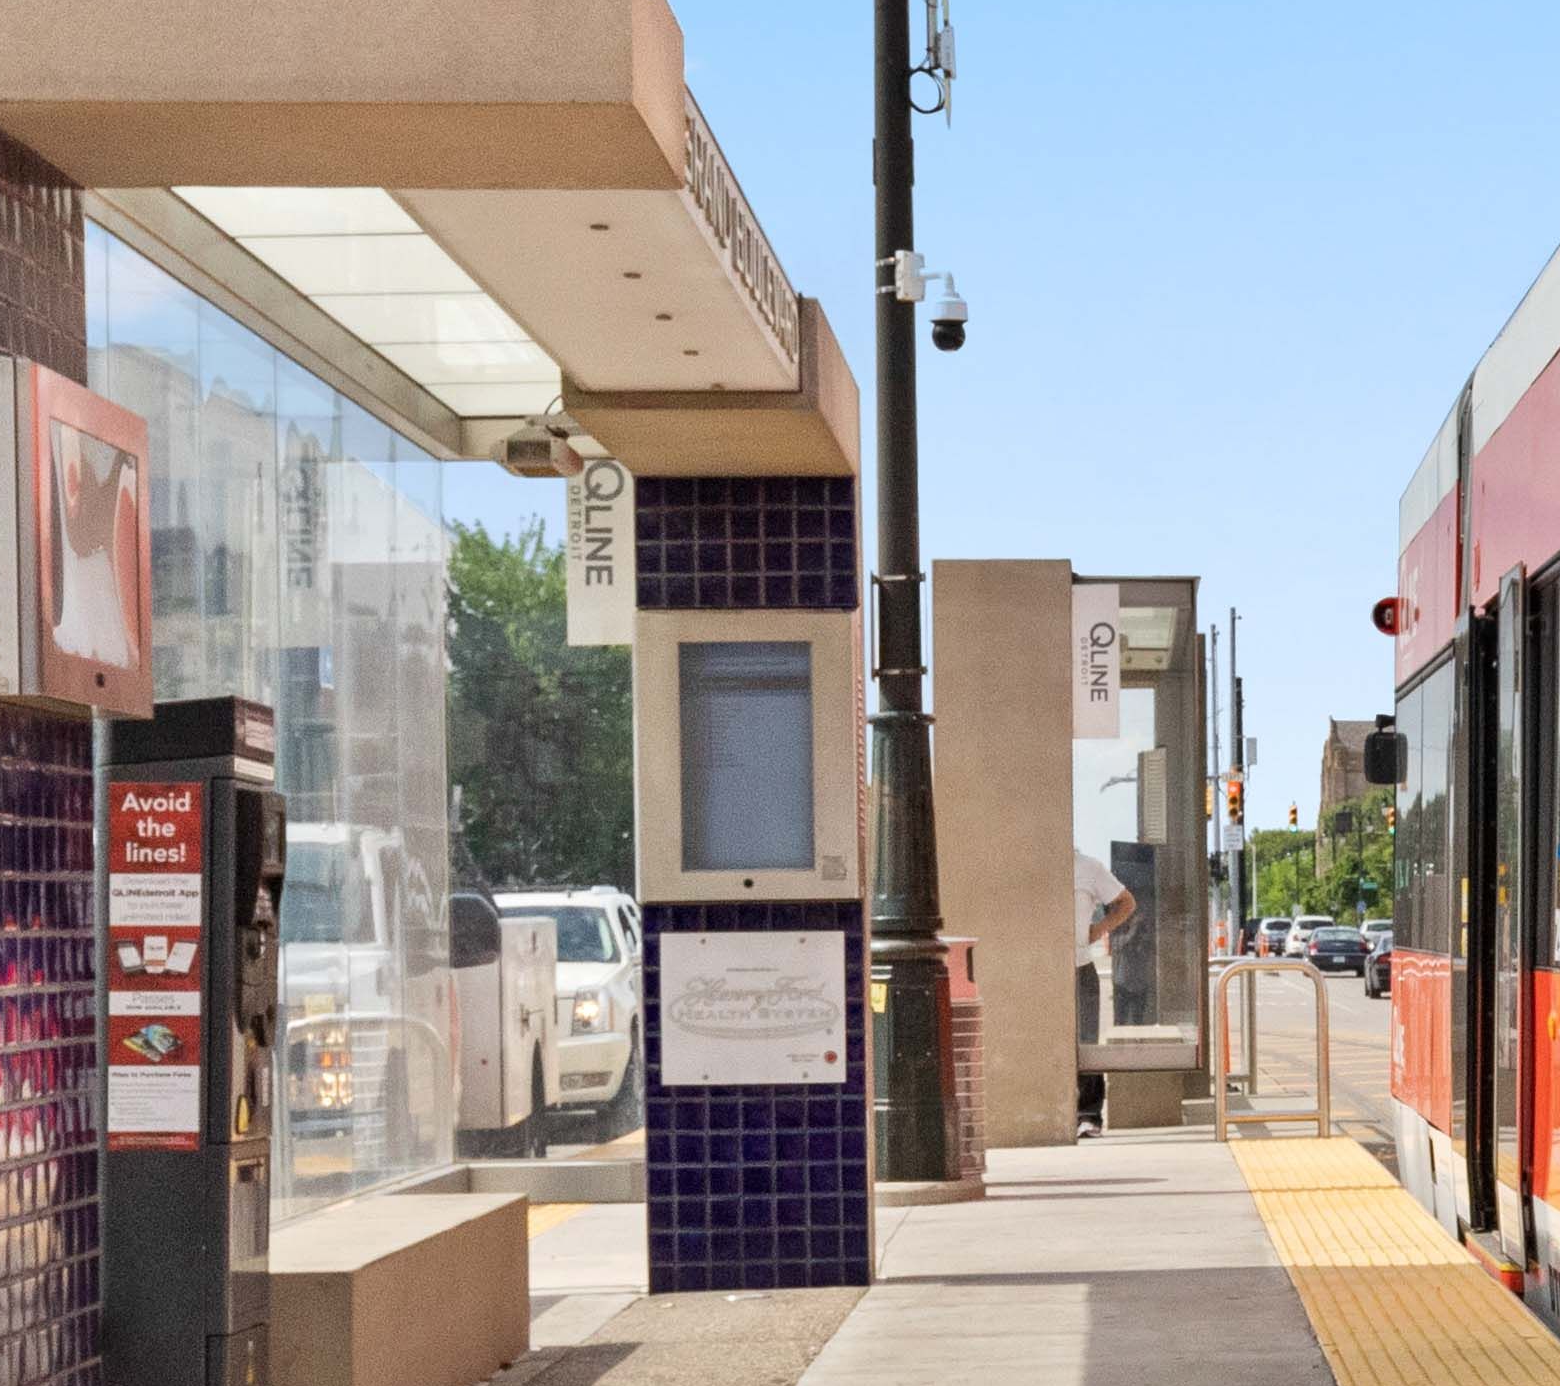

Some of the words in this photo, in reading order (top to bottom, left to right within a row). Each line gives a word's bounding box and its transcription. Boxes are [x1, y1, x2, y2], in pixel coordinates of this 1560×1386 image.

[569, 484, 582, 561] DETROIT
[584, 459, 625, 587] QLINE
[1080, 636, 1089, 686] DETROIT
[1089, 622, 1116, 702] QLINE
[121, 791, 191, 812] Avoid
[136, 816, 176, 837] the
[125, 841, 187, 863] lines!
